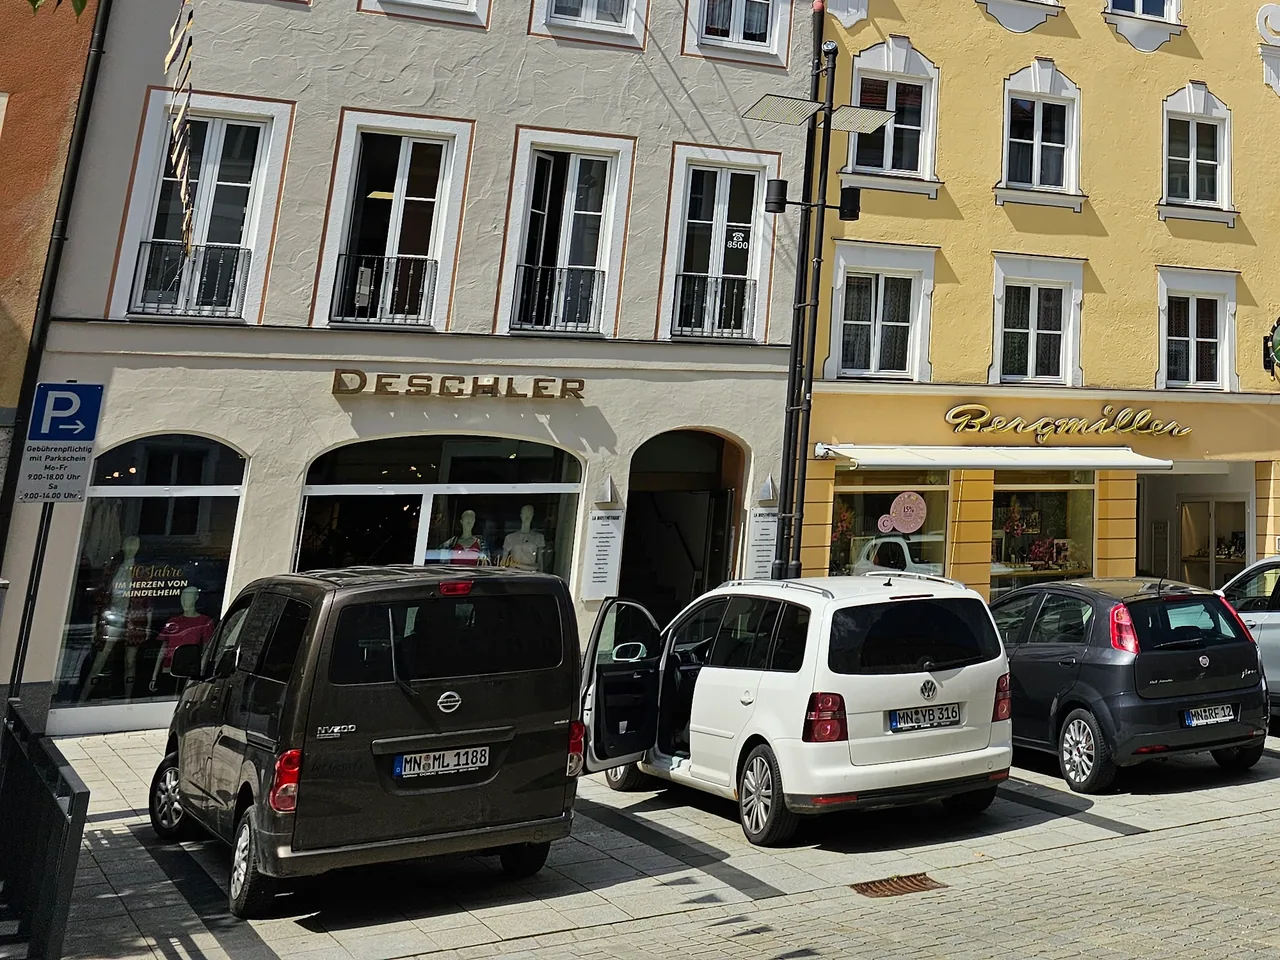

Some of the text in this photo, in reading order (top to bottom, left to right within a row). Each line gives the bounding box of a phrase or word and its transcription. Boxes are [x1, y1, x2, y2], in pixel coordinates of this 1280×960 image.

[727, 240, 748, 249] 8500
[332, 368, 585, 400] DESCHLER
[41, 390, 81, 434] P
[945, 403, 1193, 444] Bergmiller
[26, 445, 92, 453] Gebührenpflichtig
[27, 473, 64, 481] 9.00-18.00
[122, 588, 180, 598] MINDELHEIM
[128, 580, 165, 589] HERZEN
[898, 711, 914, 726] MN
[920, 708, 935, 722] YB
[937, 706, 958, 720] 316
[1190, 705, 1233, 722] MN RF 12
[403, 756, 422, 773] MN
[432, 753, 449, 770] ML
[453, 748, 487, 767] 1188
